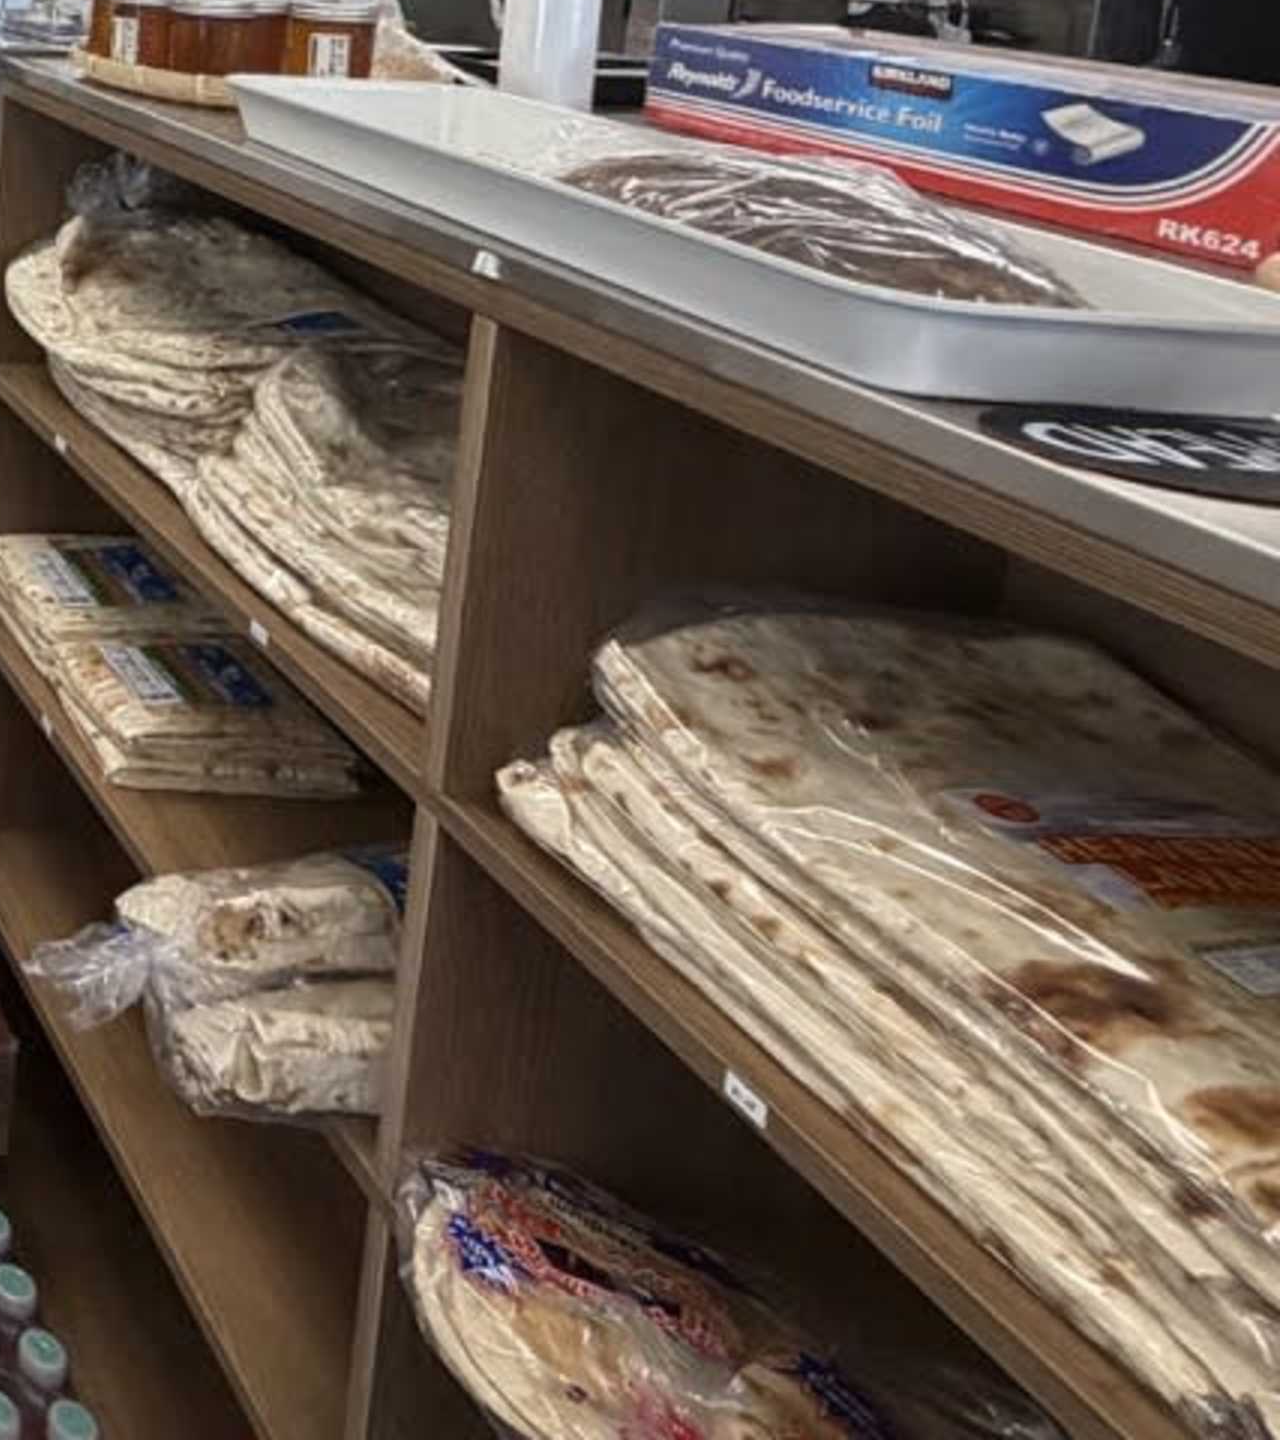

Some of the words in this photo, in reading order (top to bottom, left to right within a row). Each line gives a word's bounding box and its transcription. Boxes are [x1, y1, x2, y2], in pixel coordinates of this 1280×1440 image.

[667, 62, 738, 92] Reynolds
[871, 64, 952, 90] KIRKLAND
[761, 81, 890, 123] Foodservice
[895, 107, 944, 133] Foil
[1158, 218, 1260, 259] RK624
